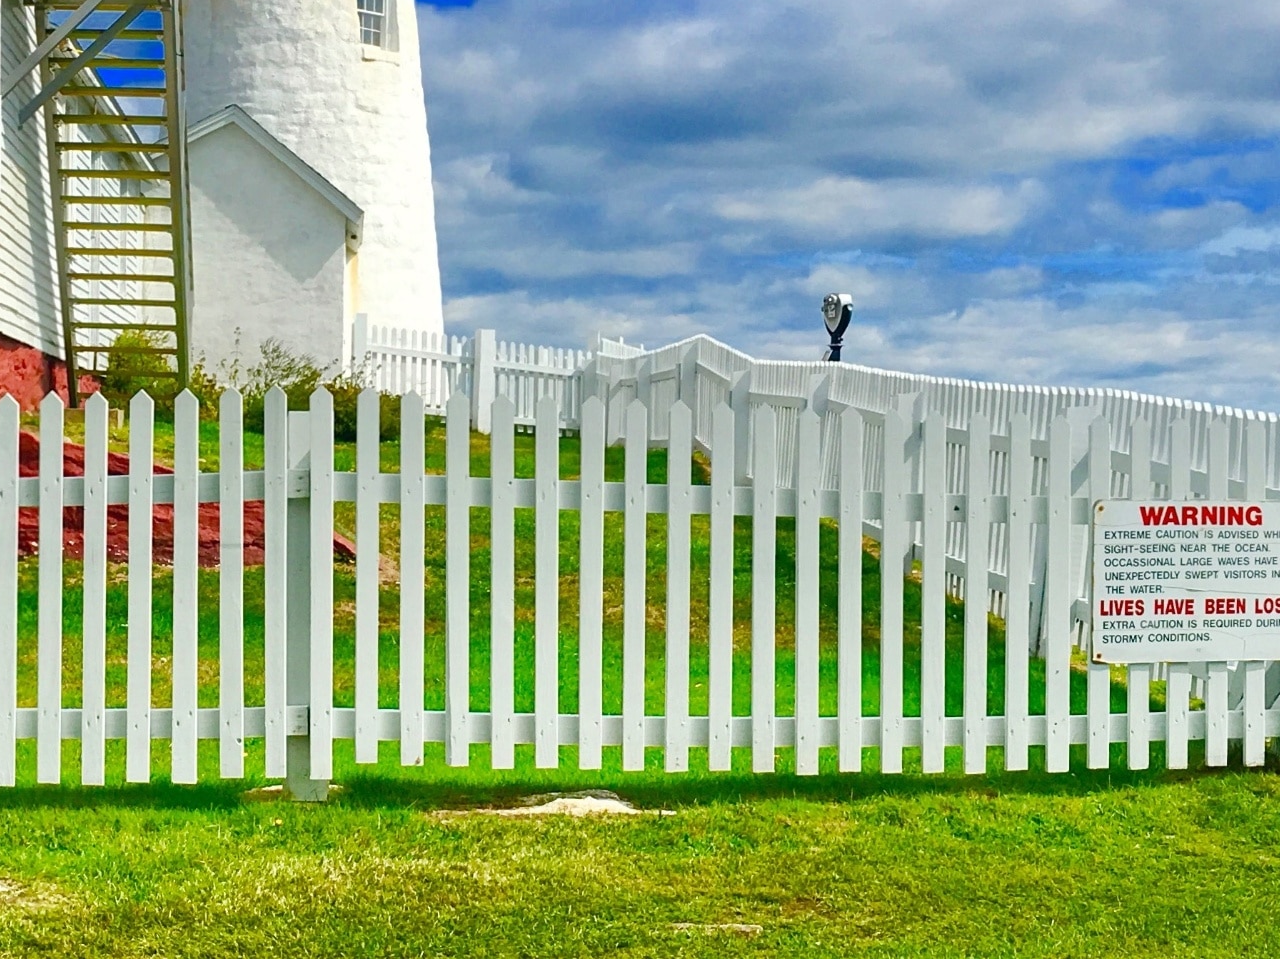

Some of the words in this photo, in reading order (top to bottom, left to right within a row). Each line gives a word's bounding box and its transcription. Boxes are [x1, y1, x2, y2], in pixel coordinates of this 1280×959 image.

[1140, 506, 1262, 526] WARNING
[1105, 530, 1151, 540] EXTREME
[1156, 530, 1198, 539] CAUTION
[1204, 530, 1213, 539] IS
[1218, 530, 1259, 539] ADVISED
[1104, 544, 1176, 554] SIGHT-SEEING
[1181, 544, 1206, 553] NEAR
[1213, 544, 1230, 552] THE
[1235, 544, 1270, 553] OCEAN.
[1104, 558, 1175, 567] OCCASSIONAL
[1181, 558, 1213, 566] LARGE
[1218, 557, 1250, 566] WAVES
[1254, 557, 1278, 565] HAVE
[1105, 571, 1180, 581] UNEXPECTEDLY
[1185, 571, 1219, 580] SWEPT
[1224, 570, 1267, 579] VISITORS
[1106, 586, 1124, 594] THE
[1130, 585, 1165, 594] WATER.
[1100, 600, 1144, 616] LIVES
[1155, 599, 1194, 615] HAVE
[1205, 599, 1246, 614] BEEN
[1103, 621, 1135, 630] EXTRA
[1140, 620, 1183, 629] CAUTION
[1188, 620, 1197, 628] IS
[1203, 619, 1252, 628] REQUIRED
[1103, 635, 1143, 644] STORMY
[1148, 633, 1212, 643] CONDITIONS.
